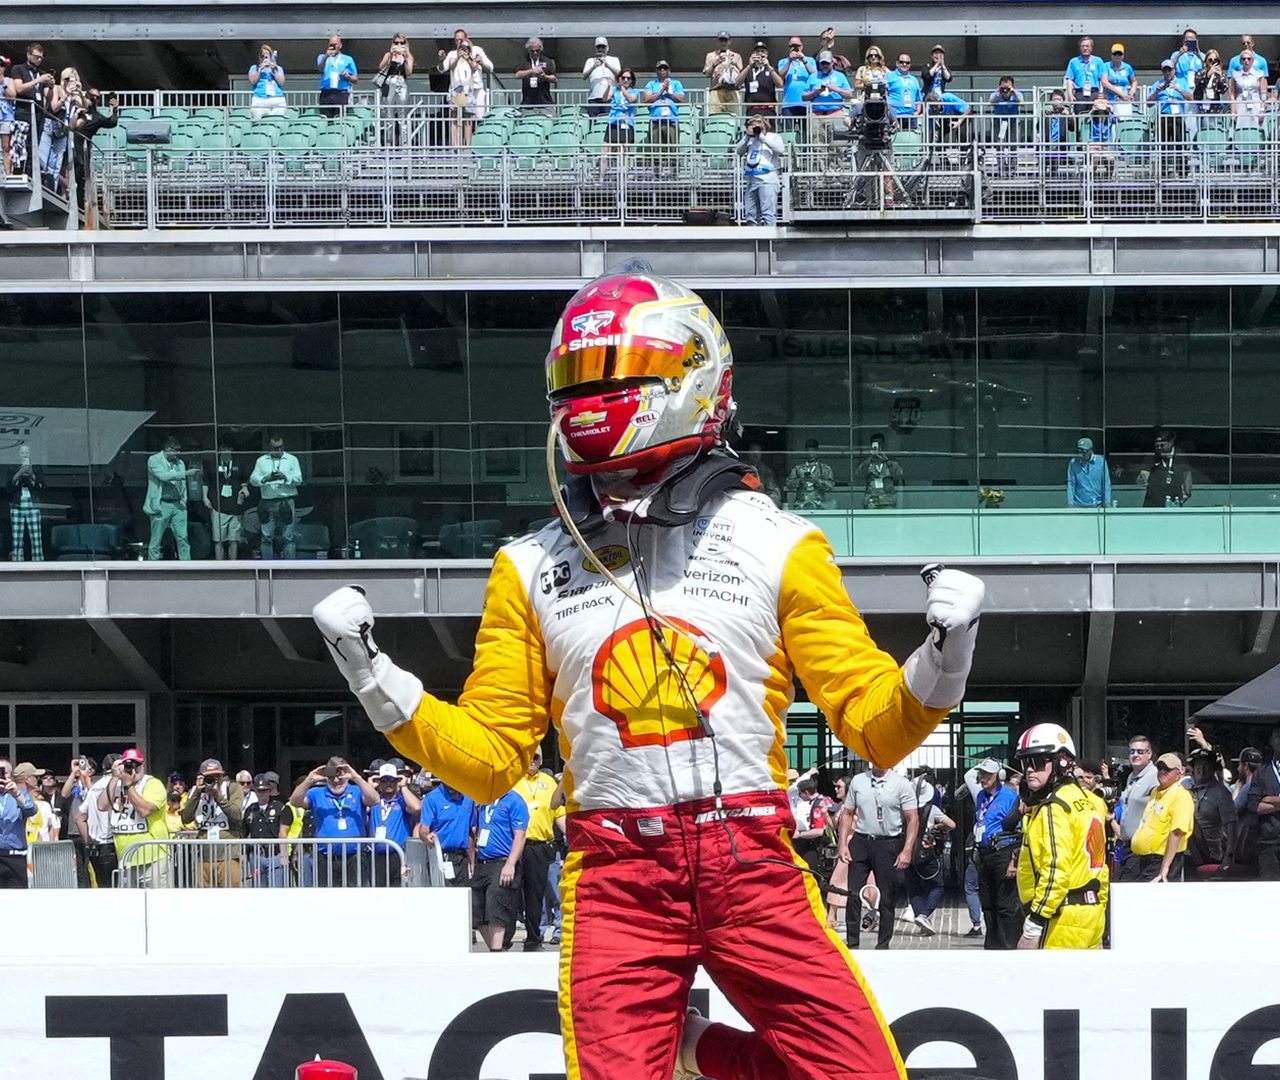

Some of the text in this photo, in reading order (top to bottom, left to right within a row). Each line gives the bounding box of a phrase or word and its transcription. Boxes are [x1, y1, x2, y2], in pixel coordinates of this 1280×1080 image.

[635, 413, 657, 424] BELL
[571, 426, 611, 438] CHEVROLET
[683, 568, 741, 587] verizon
[683, 586, 750, 607] HITACHI
[555, 595, 616, 621] TIRE RACK
